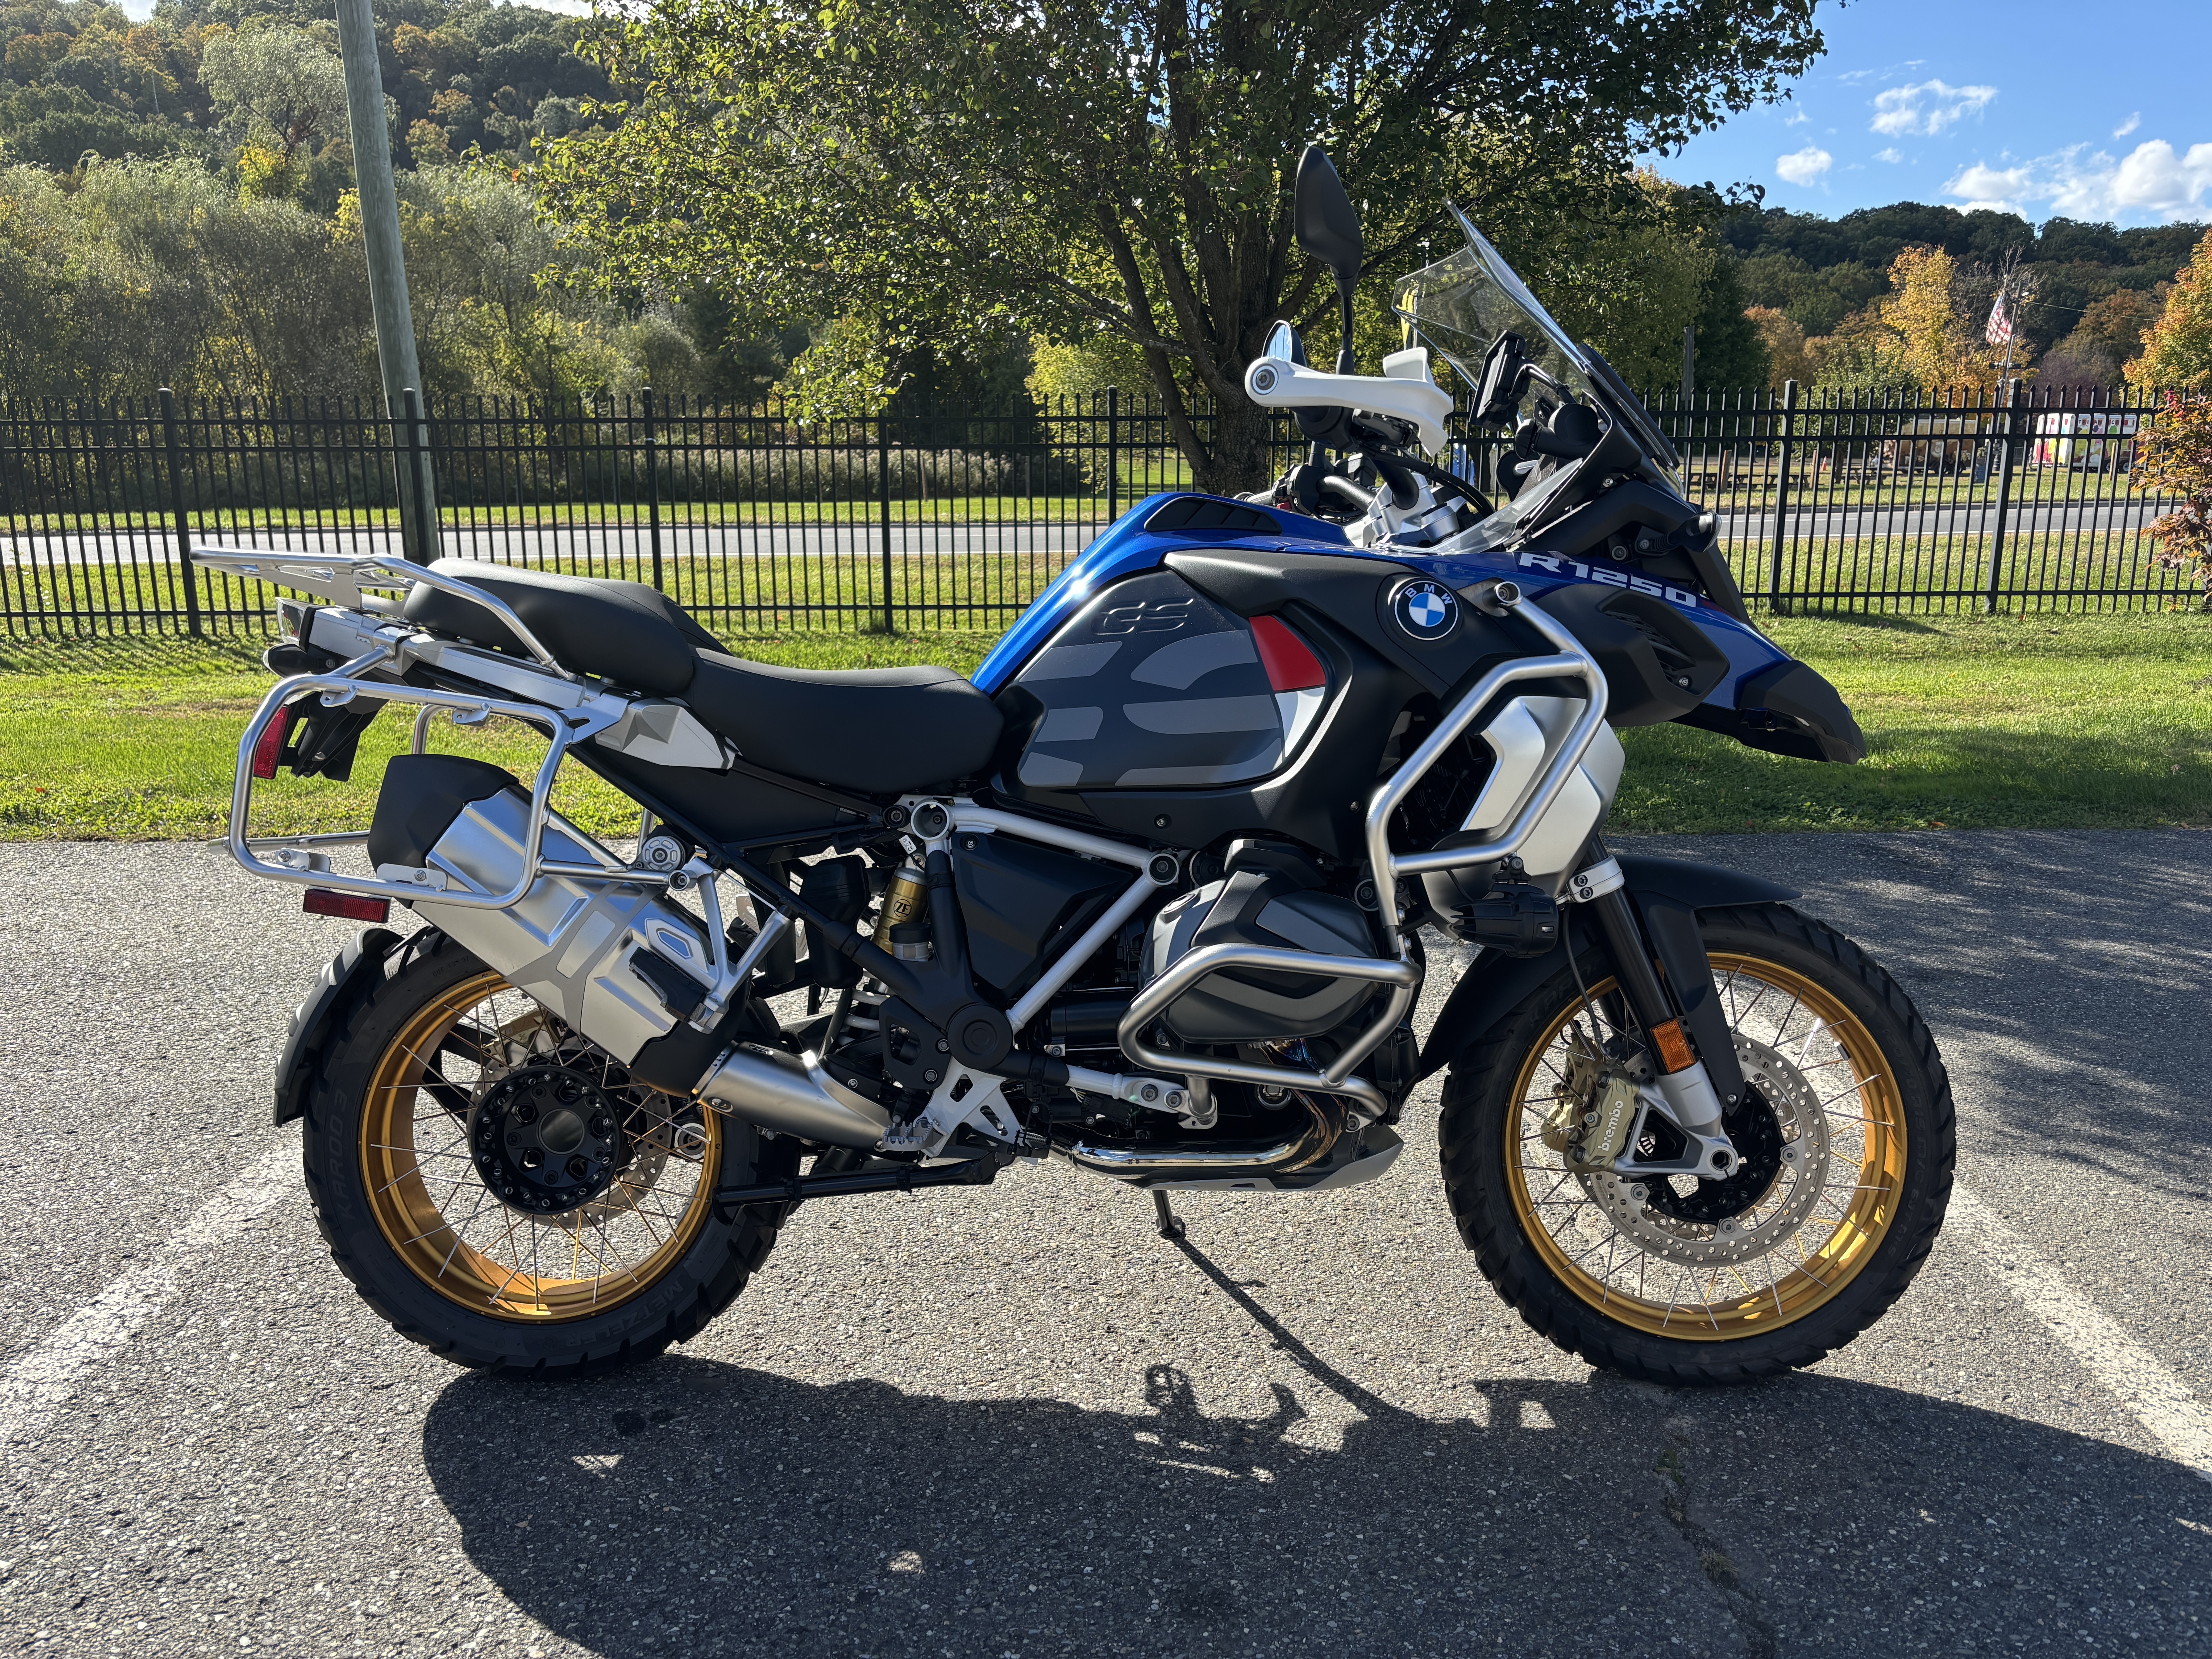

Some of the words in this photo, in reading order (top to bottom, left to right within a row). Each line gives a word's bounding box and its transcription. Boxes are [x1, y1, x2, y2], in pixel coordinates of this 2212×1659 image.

[1405, 584, 1453, 604] BMW
[1091, 598, 1194, 636] GS
[895, 901, 911, 915] ZF
[1597, 1100, 1623, 1151] brembo
[328, 1115, 357, 1220] KAROO
[565, 1280, 684, 1347] METZELER
